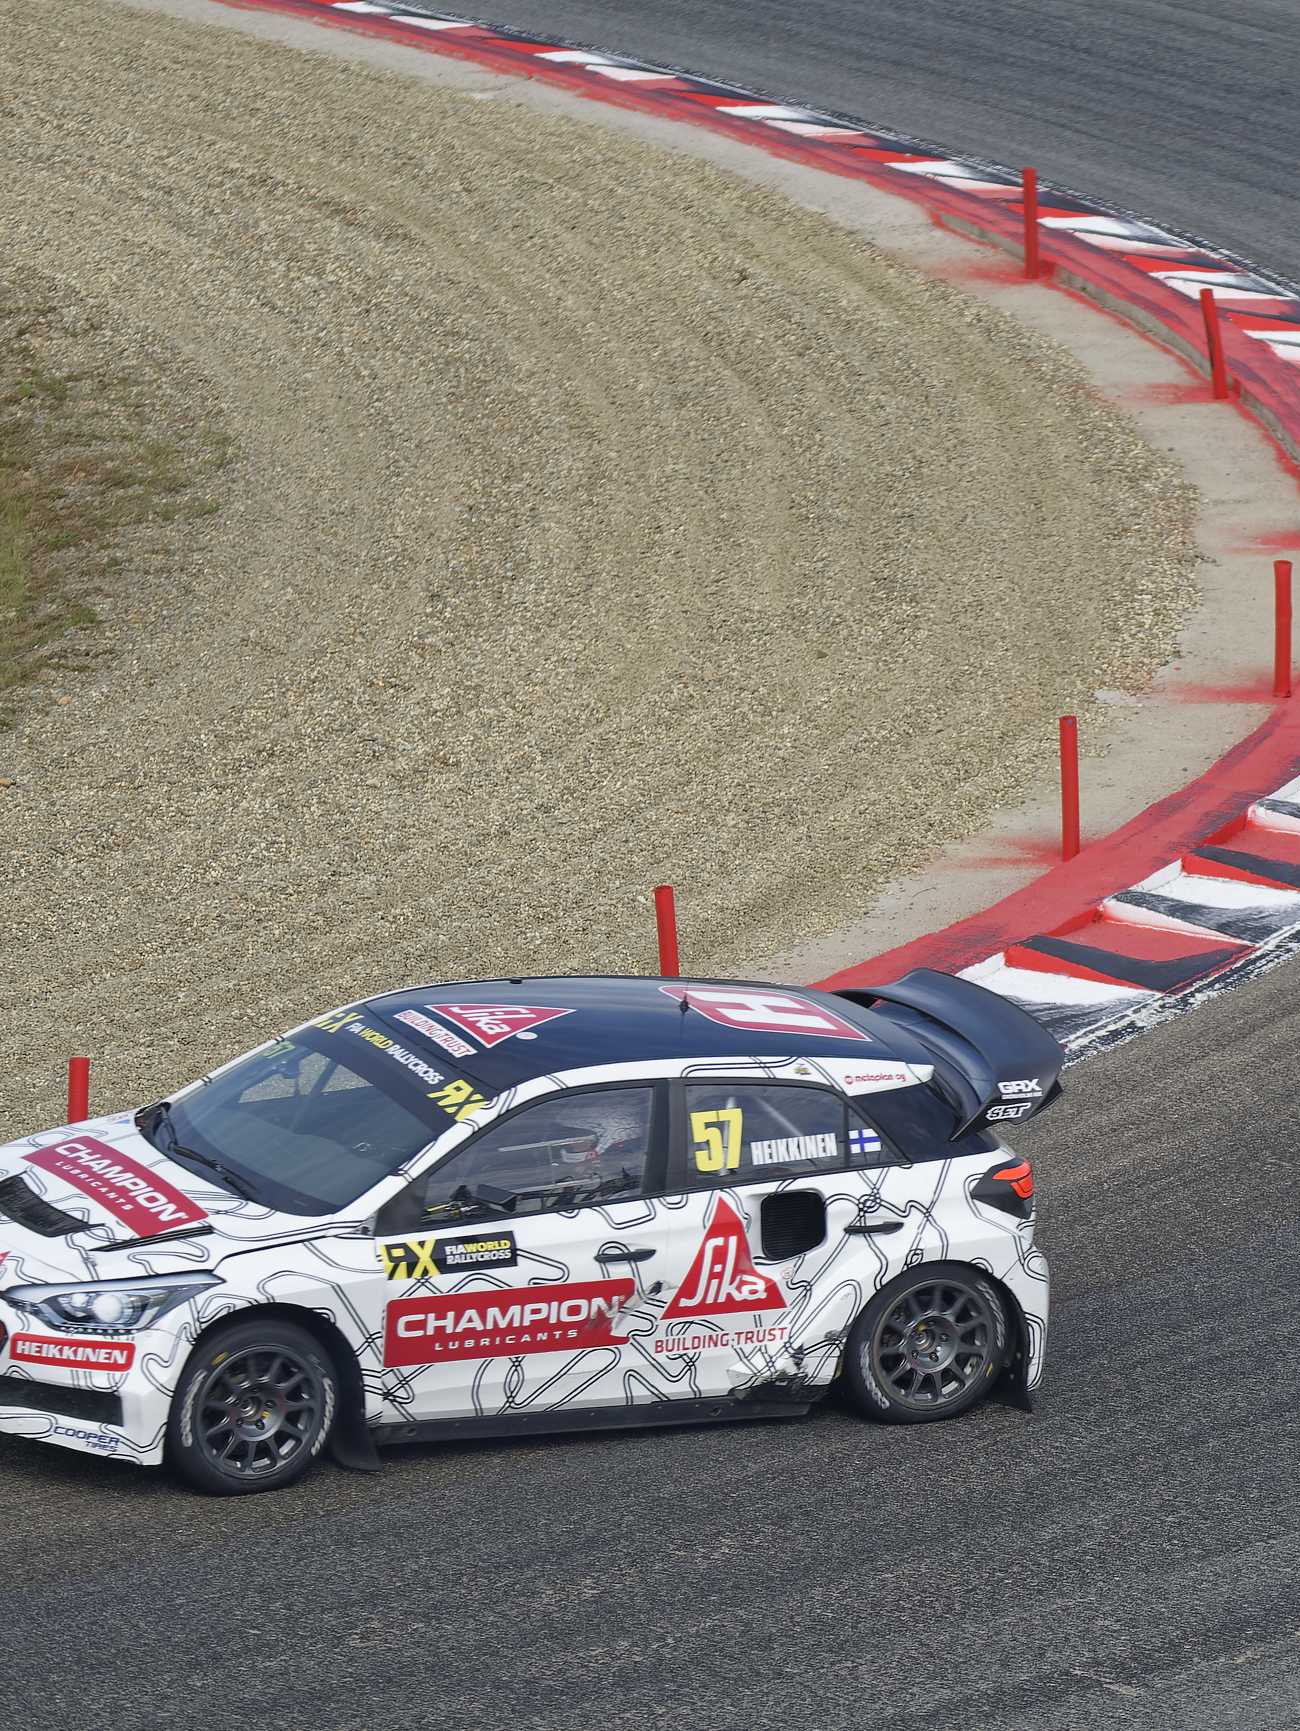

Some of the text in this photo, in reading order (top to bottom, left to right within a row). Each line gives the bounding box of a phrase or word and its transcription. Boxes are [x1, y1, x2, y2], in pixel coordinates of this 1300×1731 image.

[997, 1078, 1043, 1094] GRX
[690, 1108, 743, 1172] 57
[750, 1133, 838, 1166] HEIKKINEN
[54, 1143, 184, 1222] CHAMPION
[55, 1161, 135, 1211] LUBRICANTS
[446, 1249, 512, 1265] RALLYCROSS
[679, 1235, 768, 1308] Sika
[396, 1296, 617, 1338] CHAMPION
[16, 1340, 128, 1365] HEIKKINEN
[434, 1329, 579, 1351] LUBRICANTS
[654, 1327, 788, 1354] BUILDING TRUST
[53, 1425, 121, 1446] COOPER
